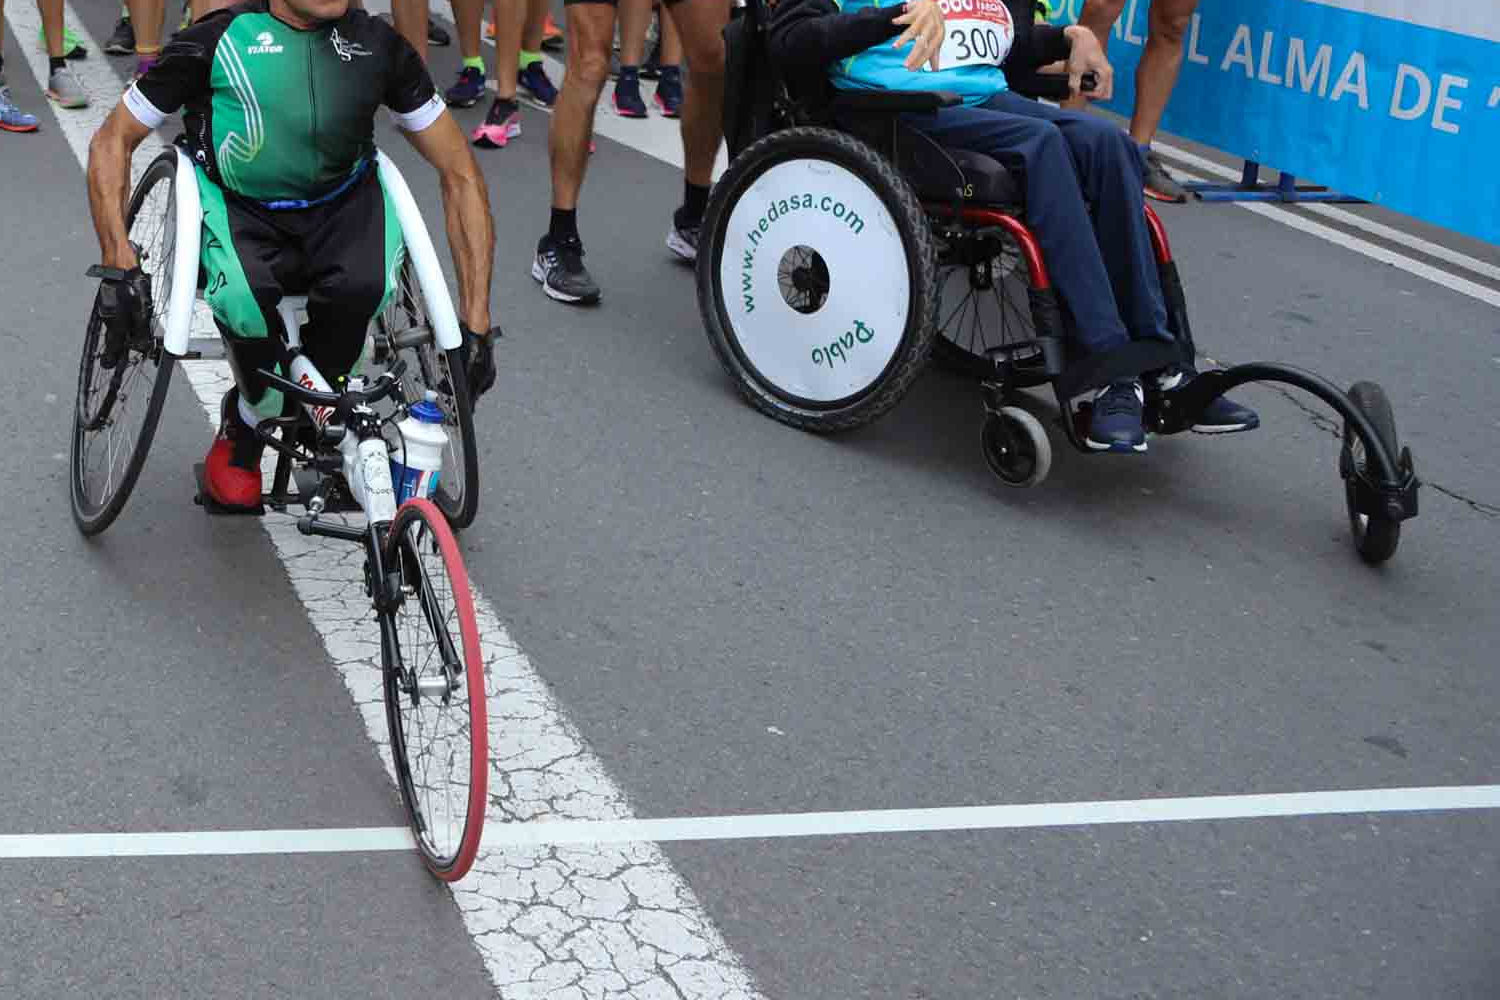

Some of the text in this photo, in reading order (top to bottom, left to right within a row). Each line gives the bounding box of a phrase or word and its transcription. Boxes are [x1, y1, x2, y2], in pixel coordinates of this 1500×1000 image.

[950, 27, 1000, 61] 300
[1221, 23, 1369, 112] ALMA
[1389, 63, 1469, 135] DE
[741, 192, 866, 313] www.hedasa.com
[811, 320, 875, 368] Pablo
